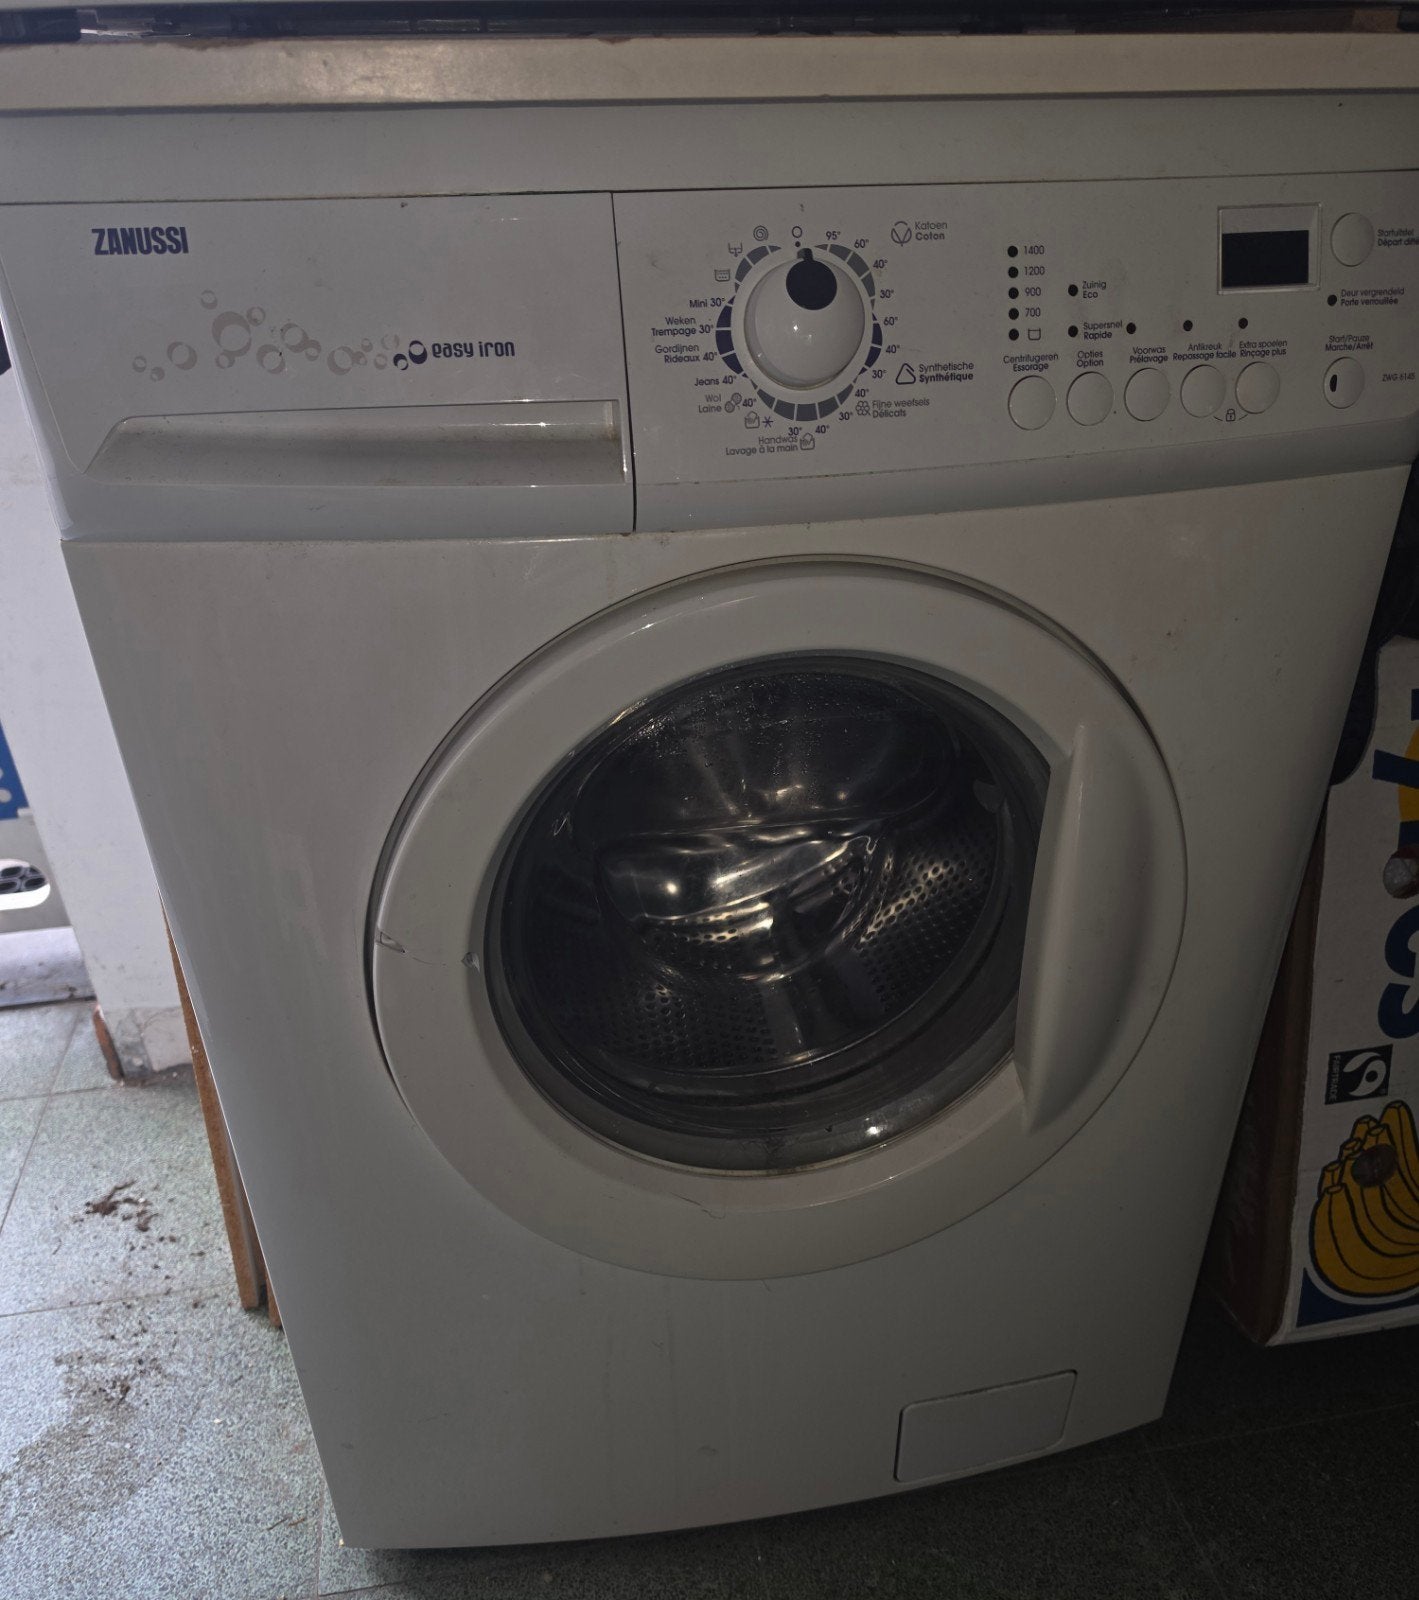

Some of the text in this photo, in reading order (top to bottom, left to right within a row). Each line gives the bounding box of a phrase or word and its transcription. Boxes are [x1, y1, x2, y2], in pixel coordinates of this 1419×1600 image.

[915, 221, 948, 230] Katoen
[92, 226, 189, 255] ZANUSSI
[915, 232, 945, 240] Coton
[1024, 245, 1044, 255] 1400
[1024, 266, 1045, 276] 1200
[1082, 280, 1106, 292] Zuinig
[1025, 287, 1041, 296] 900
[1083, 290, 1098, 298] Eco
[1340, 289, 1358, 298] Deur
[689, 299, 708, 308] Mini
[1340, 296, 1358, 306] Porte
[1026, 308, 1041, 317] 700
[665, 316, 696, 325] Weken
[1083, 320, 1122, 332] Supersnel
[652, 328, 696, 337] Trempage
[1084, 330, 1112, 340] Rapide
[1239, 339, 1288, 350] Extra spoelen
[1329, 335, 1370, 344] Start/Pauze
[432, 341, 515, 358] easy iron
[655, 344, 700, 354] Gordijnen
[1132, 346, 1166, 356] Voorwas
[1188, 342, 1222, 352] Antikreuk
[1272, 348, 1286, 356] plus
[664, 354, 700, 363] Rideaux
[1003, 353, 1058, 364] Centrifugeren
[1078, 350, 1103, 360] Opties
[1173, 350, 1236, 361] Repassage facile
[919, 362, 974, 374] Synthetische
[1012, 362, 1049, 372] Essorage
[1076, 358, 1104, 368] Option
[694, 378, 720, 386] Jeans
[919, 371, 974, 383] Synthétique
[1382, 374, 1398, 382] ZWG
[705, 394, 721, 402] Wol
[698, 404, 722, 413] Laine
[872, 398, 930, 410] Fijne weefsels
[872, 408, 906, 418] Délicats
[758, 435, 798, 445] Handwas
[726, 447, 757, 456] Lavage
[776, 444, 798, 452] main
[1328, 1054, 1342, 1102] FAIRTRADE
